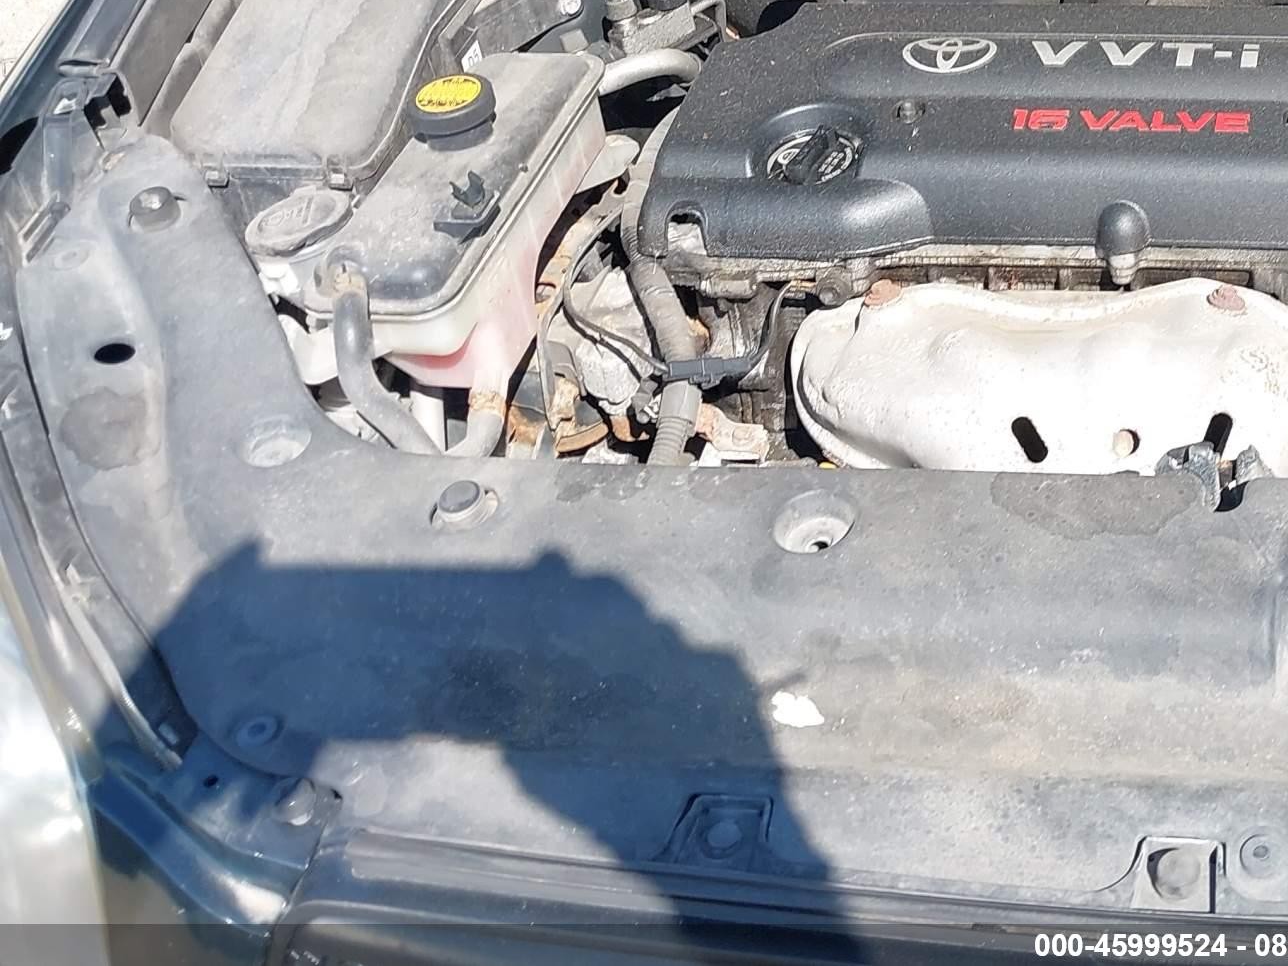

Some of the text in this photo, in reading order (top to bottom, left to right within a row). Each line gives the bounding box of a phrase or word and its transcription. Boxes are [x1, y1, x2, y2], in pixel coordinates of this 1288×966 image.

[1032, 40, 1261, 69] VVT-i
[1014, 109, 1252, 132] 16 VALVE
